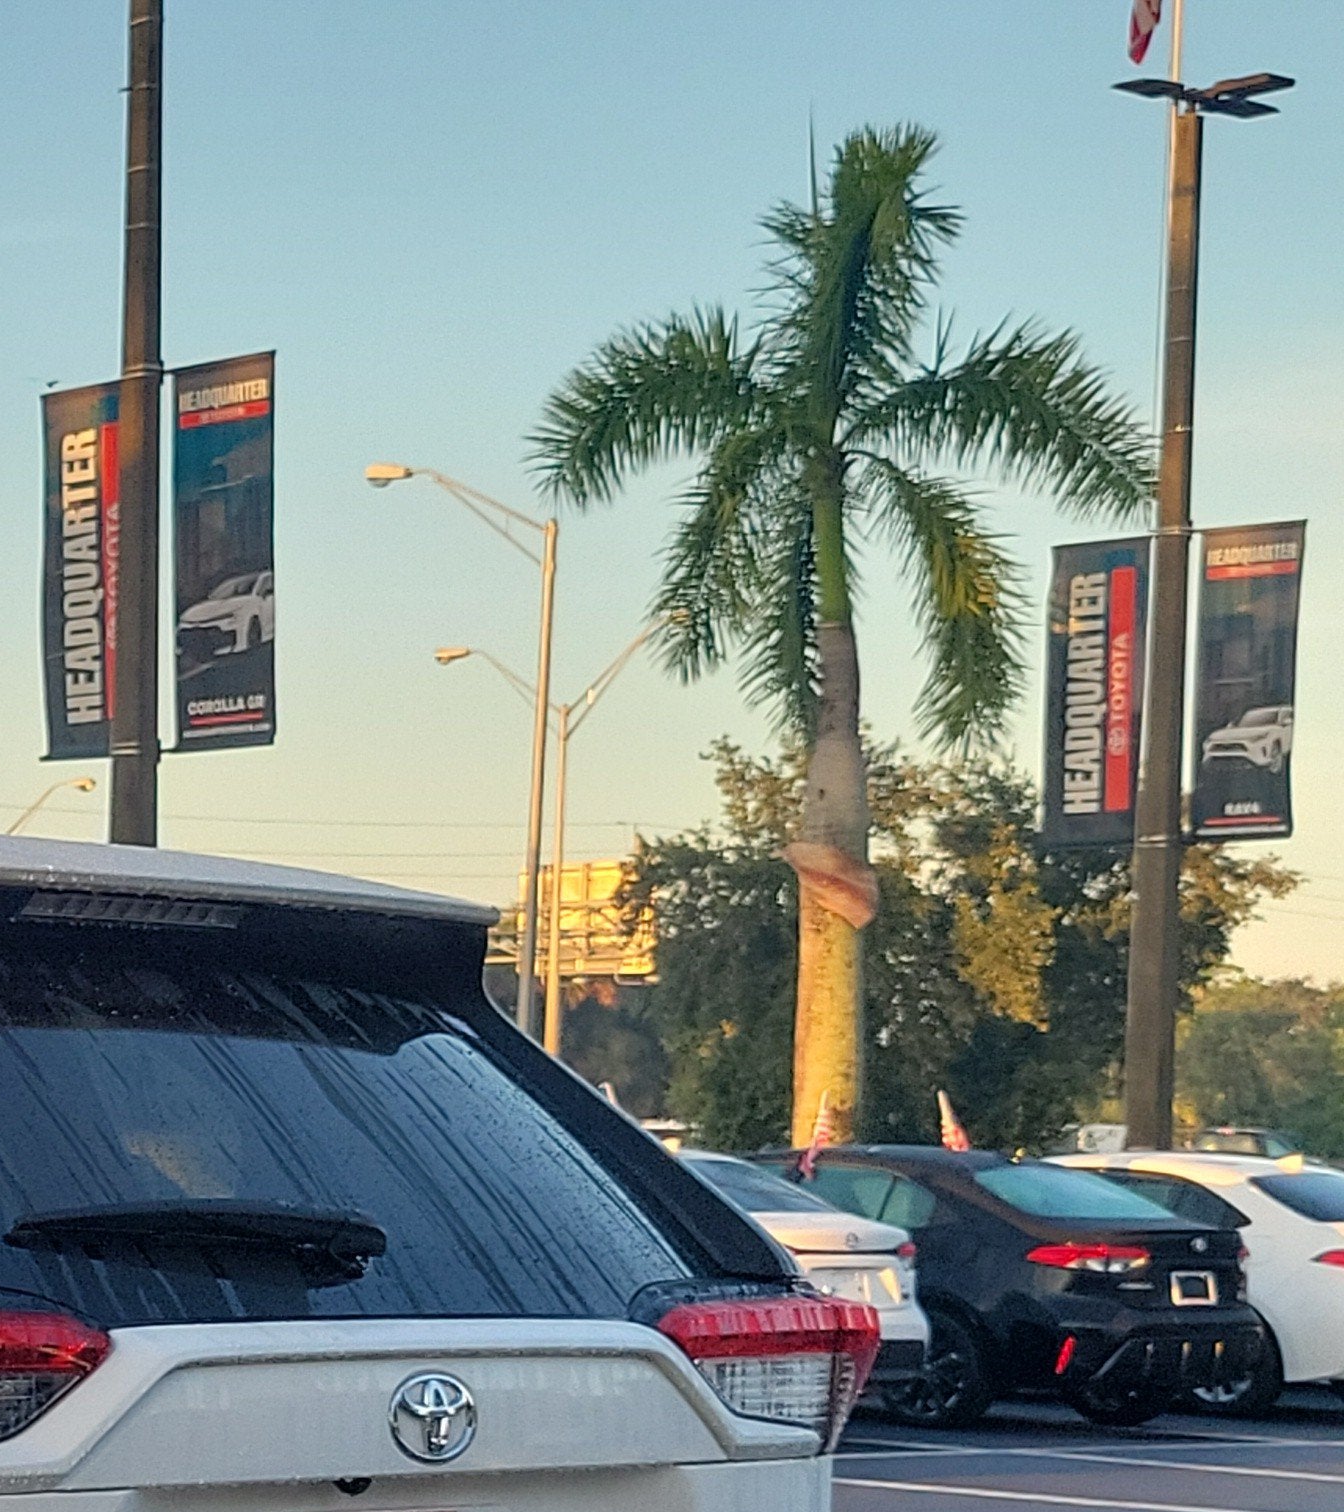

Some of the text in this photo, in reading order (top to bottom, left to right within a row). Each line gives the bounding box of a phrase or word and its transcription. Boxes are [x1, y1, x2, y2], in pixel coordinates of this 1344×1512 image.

[60, 426, 104, 725] HEADQUARTER
[1062, 571, 1108, 814] HEADQUARTER
[1110, 632, 1130, 722] TOYOTA
